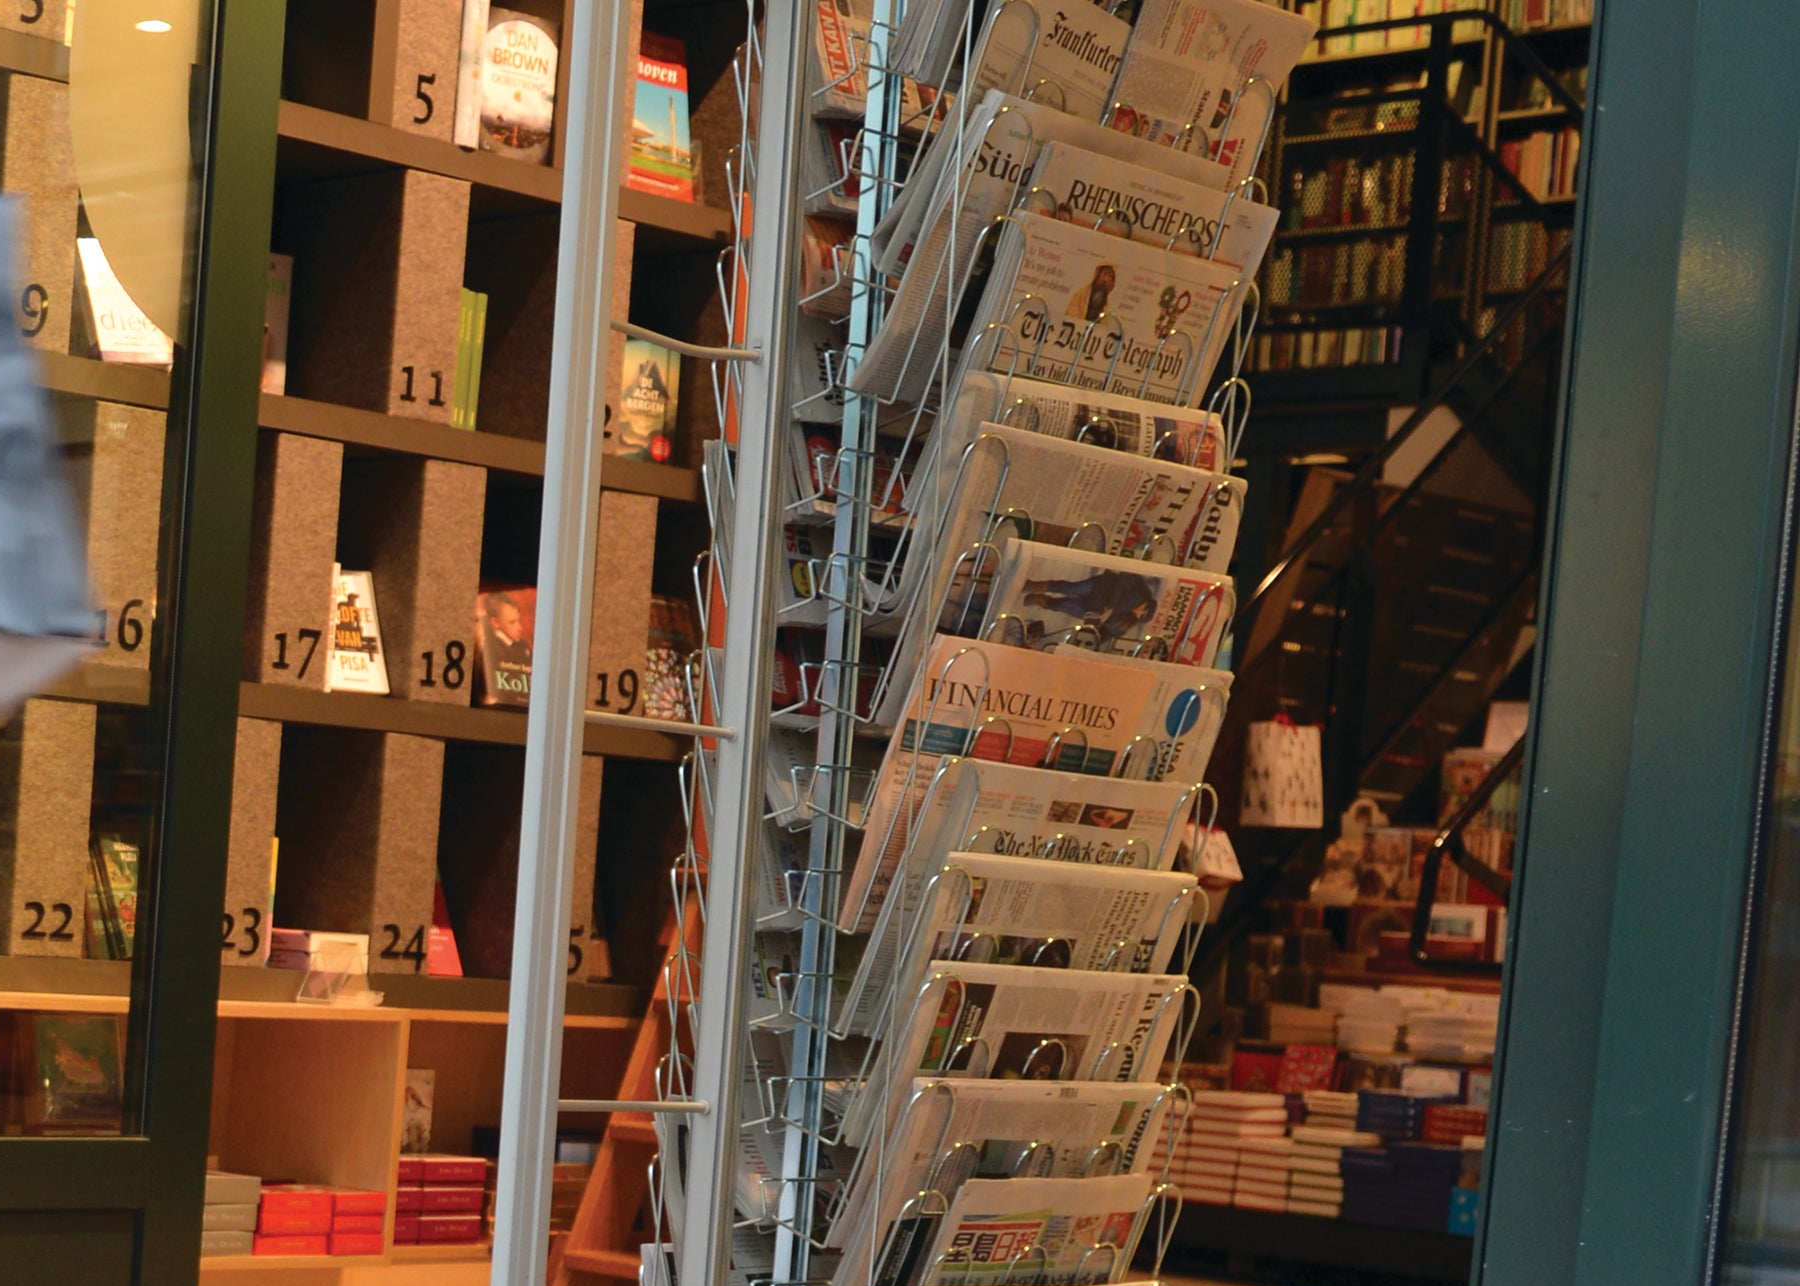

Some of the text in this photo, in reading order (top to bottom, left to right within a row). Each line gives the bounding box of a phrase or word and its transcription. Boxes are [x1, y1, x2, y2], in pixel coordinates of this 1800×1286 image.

[507, 29, 539, 51] DAN
[823, 14, 846, 57] KAN
[1044, 11, 1122, 75] Frankfurter
[493, 47, 550, 75] BROWN
[413, 73, 437, 125] 5
[1067, 179, 1180, 236] RHEINISCHE
[20, 283, 49, 338] 9
[1020, 310, 1055, 344] The
[400, 366, 446, 407] 11
[272, 628, 322, 680] 17
[340, 654, 369, 671] PISA
[420, 640, 466, 690] 18
[595, 668, 640, 715] 19
[929, 678, 1119, 731] FINANCIAL TIMES
[994, 829, 1023, 857] The
[21, 901, 74, 941] 22
[222, 907, 261, 956] 23
[380, 923, 427, 973] 24
